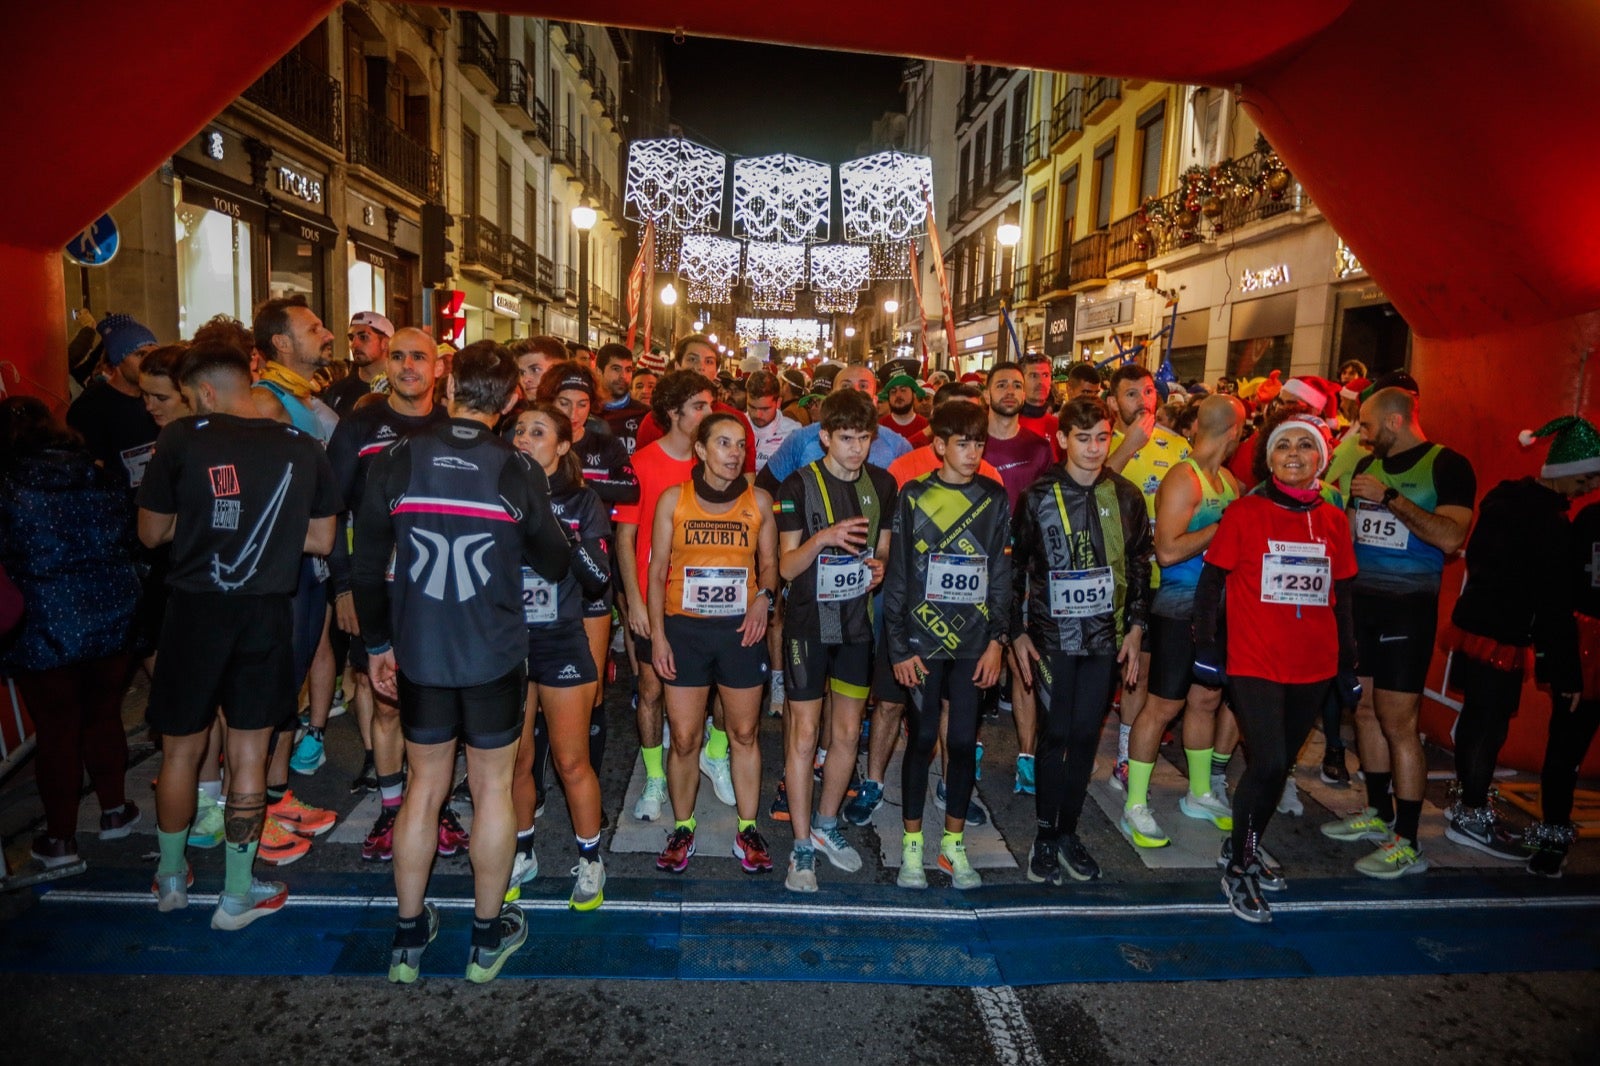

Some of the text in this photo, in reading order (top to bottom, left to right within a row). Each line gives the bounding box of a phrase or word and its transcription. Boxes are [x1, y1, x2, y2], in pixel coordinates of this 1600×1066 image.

[213, 196, 241, 217] TOUS
[301, 226, 320, 242] TOUS
[369, 253, 384, 267] TOUS
[689, 522, 741, 530] ClubDeportivo
[1362, 518, 1396, 536] 815
[1275, 543, 1286, 552] 30
[834, 569, 864, 588] 962
[941, 573, 979, 590] 880
[1273, 574, 1323, 591] 1230
[697, 586, 737, 602] 528
[1061, 586, 1106, 603] 1051
[917, 603, 961, 650] KIDS
